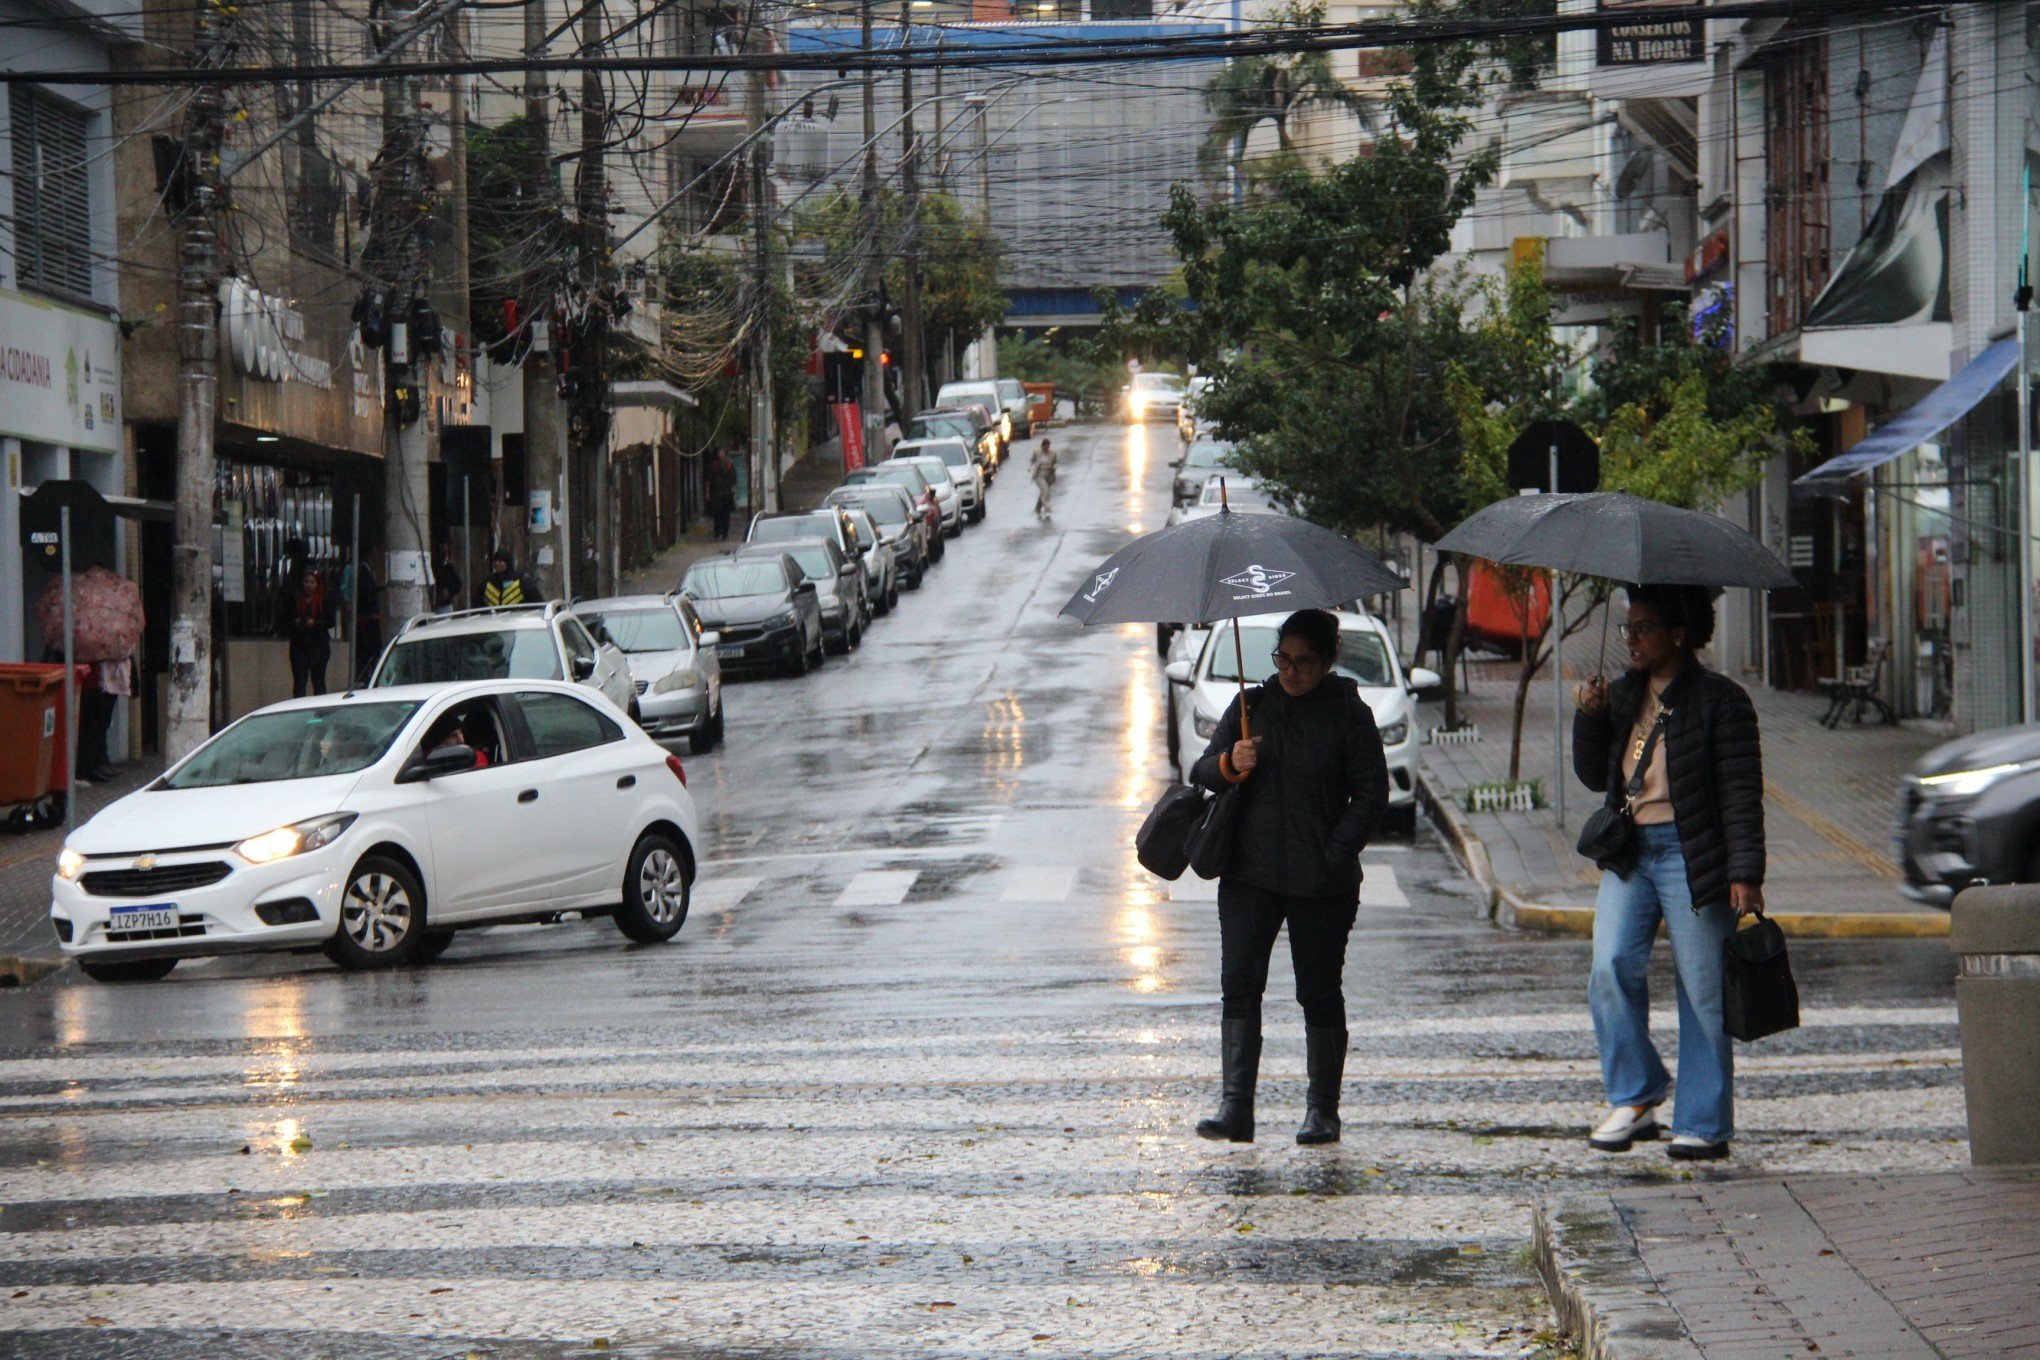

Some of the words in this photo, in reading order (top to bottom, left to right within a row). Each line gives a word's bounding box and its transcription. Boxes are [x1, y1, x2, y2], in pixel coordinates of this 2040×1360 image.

[1612, 41, 1633, 60] NA
[1638, 39, 1691, 60] HORA!
[8, 347, 51, 389] CIDADANIA
